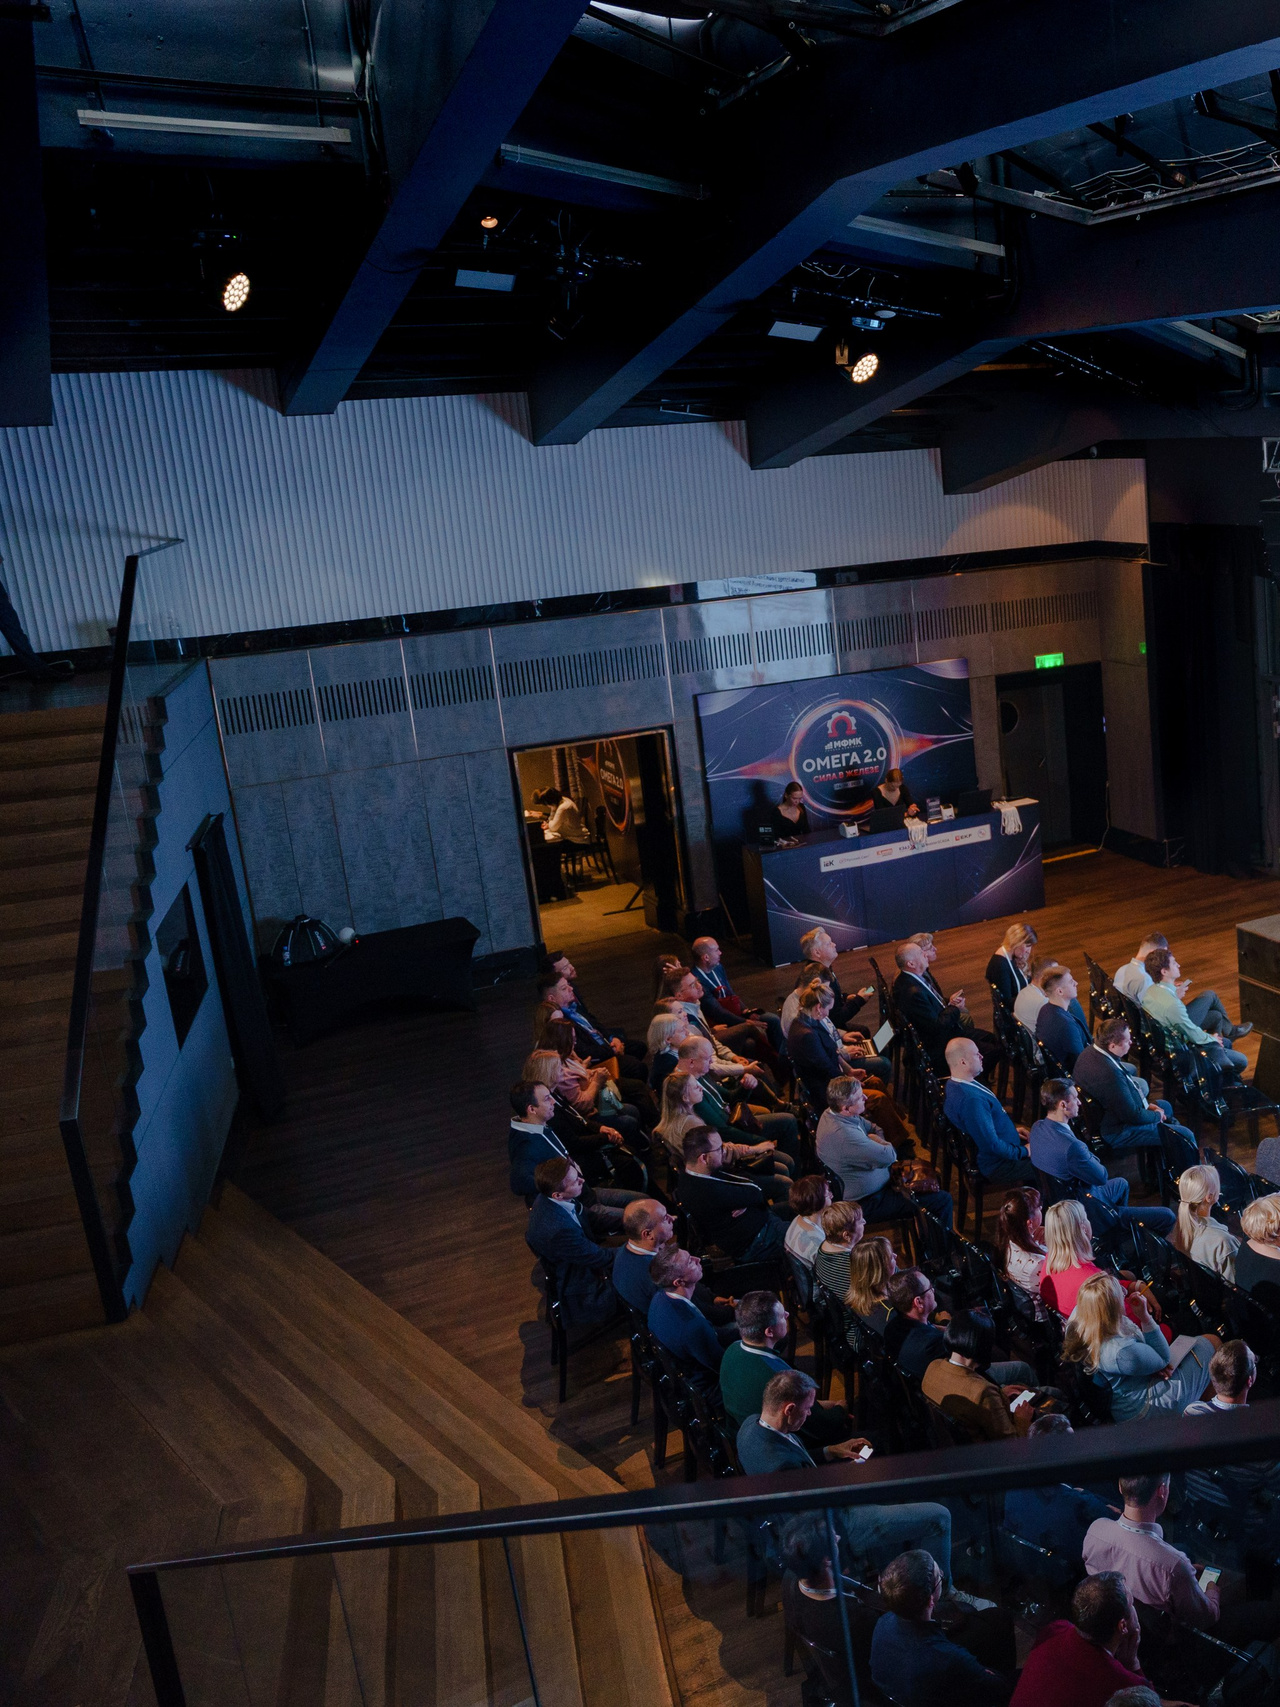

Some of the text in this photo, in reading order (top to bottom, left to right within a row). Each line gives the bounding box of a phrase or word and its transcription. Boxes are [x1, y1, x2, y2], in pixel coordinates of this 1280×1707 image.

[833, 737, 862, 749] МФМК
[802, 746, 887, 773] ОМЕГА 2.0
[813, 766, 880, 783] СИЛА В ЖЕЛЕЗЕ
